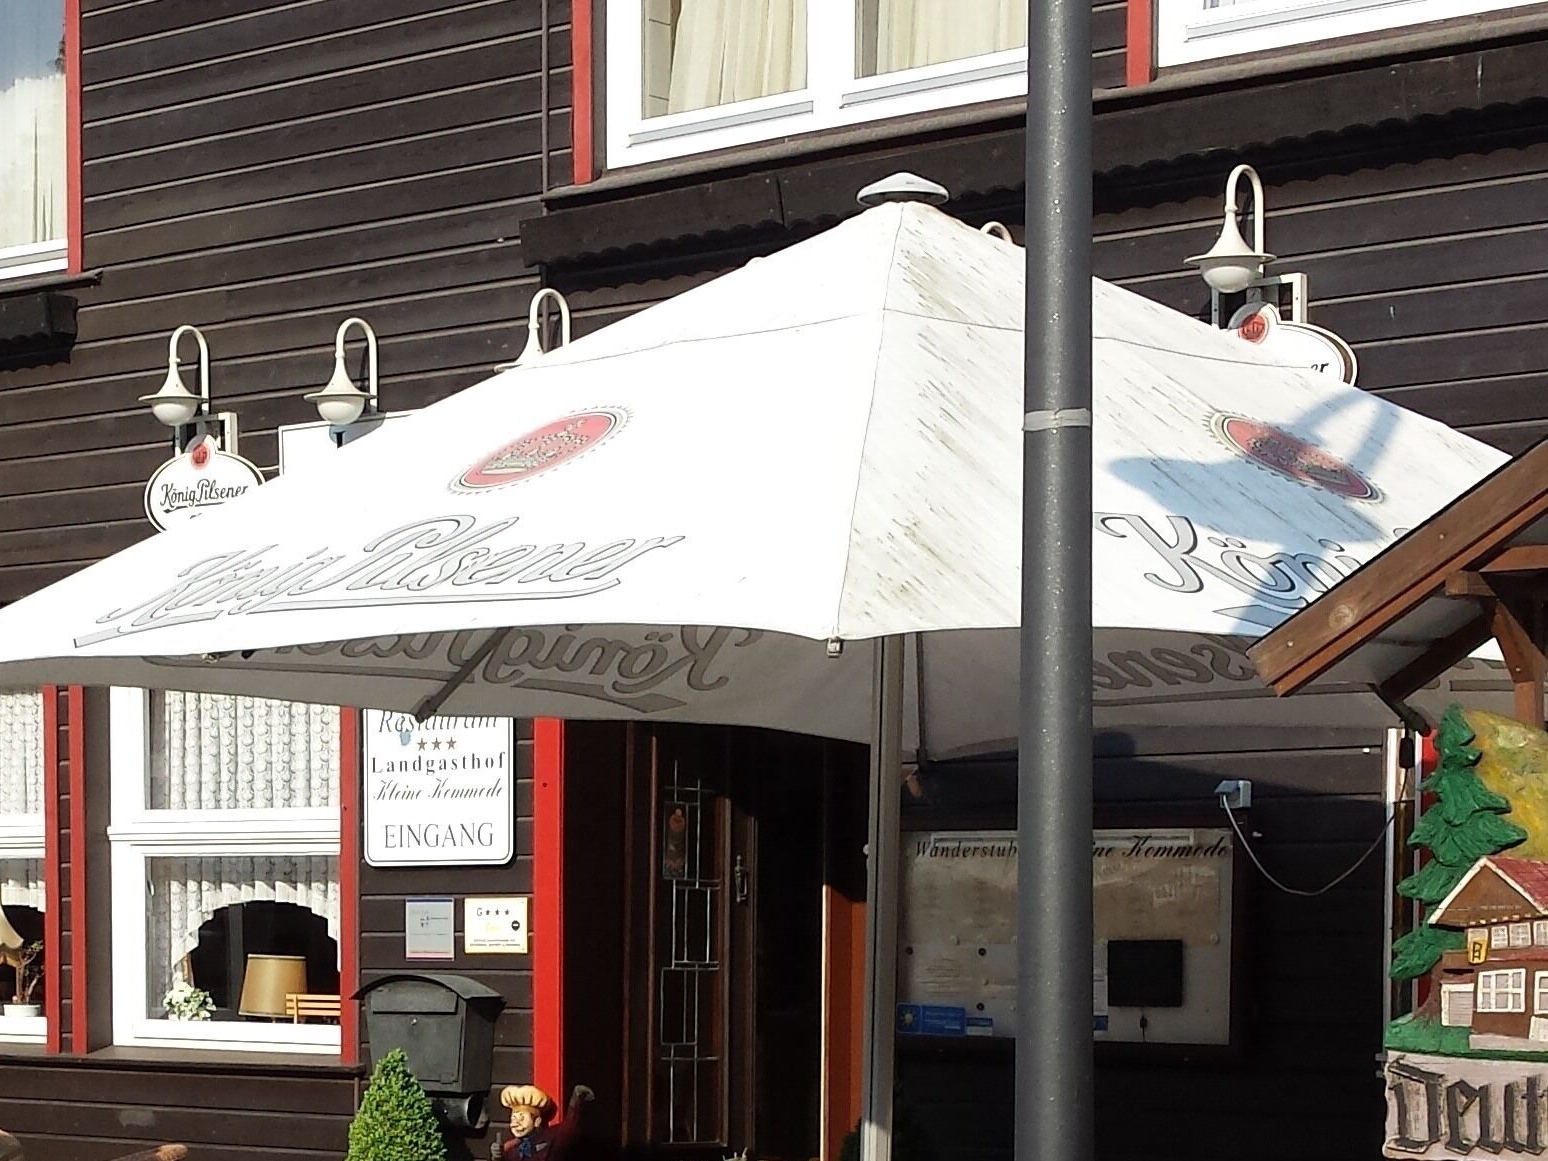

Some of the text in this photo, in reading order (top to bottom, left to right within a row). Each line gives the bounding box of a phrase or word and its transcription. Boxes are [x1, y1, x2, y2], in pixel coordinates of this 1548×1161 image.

[160, 479, 249, 508] König Pilsener
[96, 514, 685, 626] König Pilsener
[372, 752, 505, 775] Landgasthof
[373, 779, 421, 801] Kleine
[385, 822, 493, 848] EINGANG
[915, 840, 1018, 858] Wanderstub
[1123, 835, 1228, 858] Kommode
